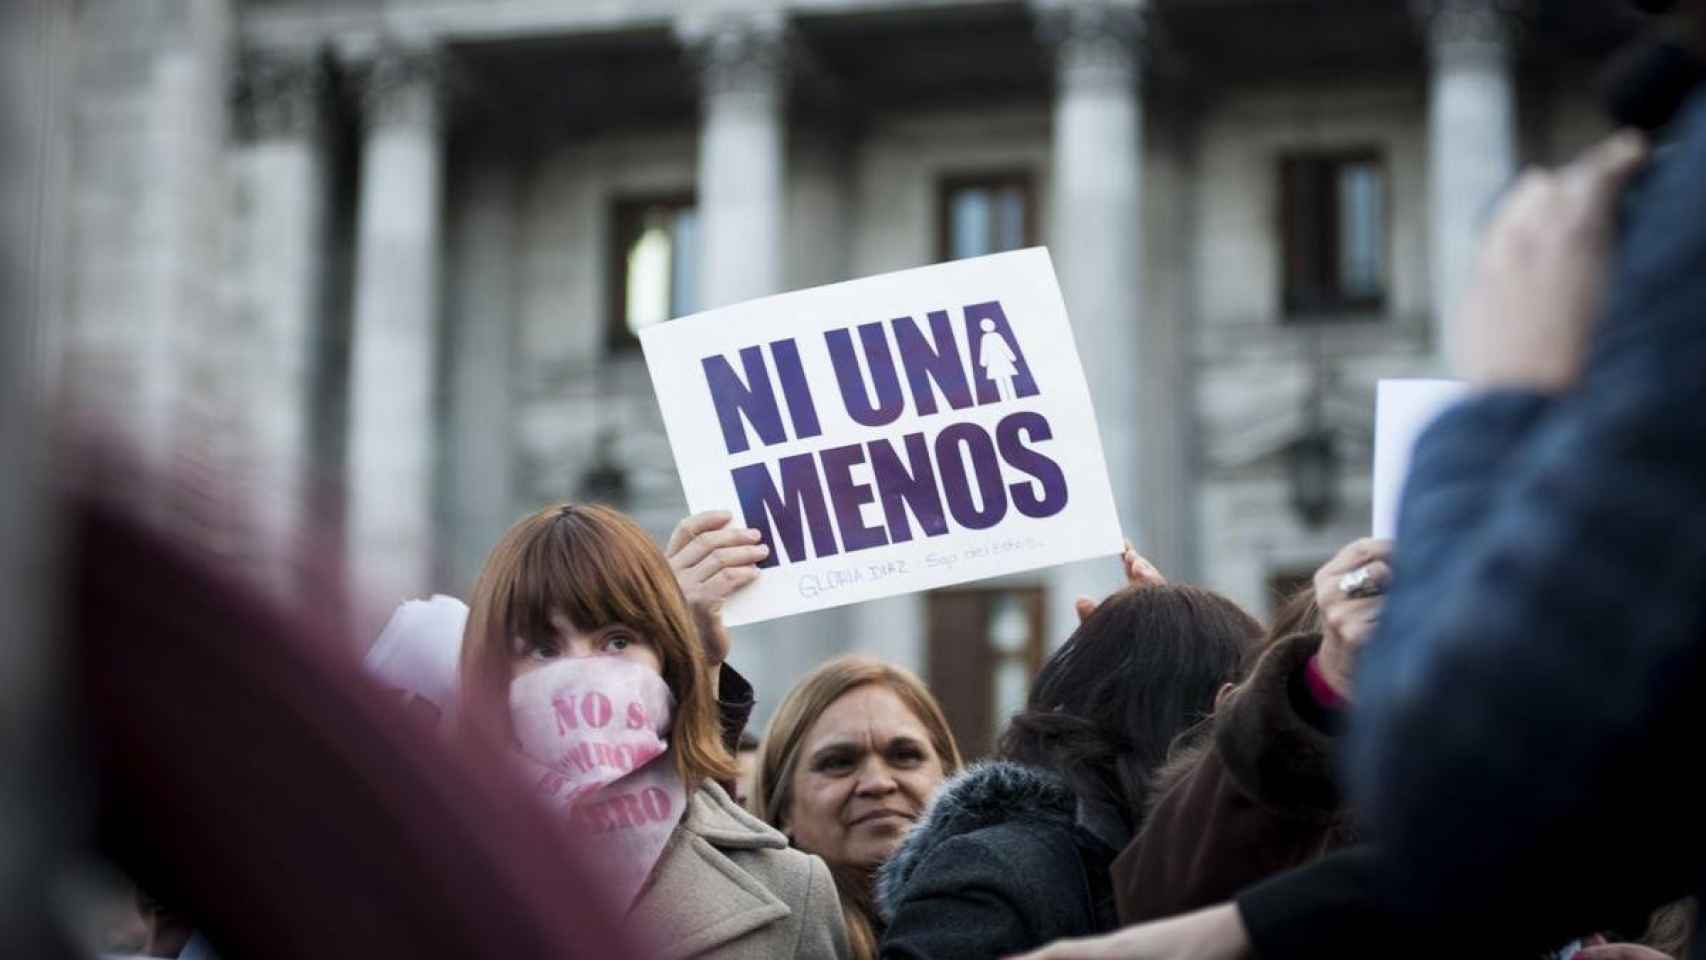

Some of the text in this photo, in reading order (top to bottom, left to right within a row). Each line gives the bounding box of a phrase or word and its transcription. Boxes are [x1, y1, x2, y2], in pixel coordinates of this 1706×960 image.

[700, 300, 1041, 456] NI UNA
[730, 410, 1069, 569] MENOS
[552, 690, 613, 737] NO
